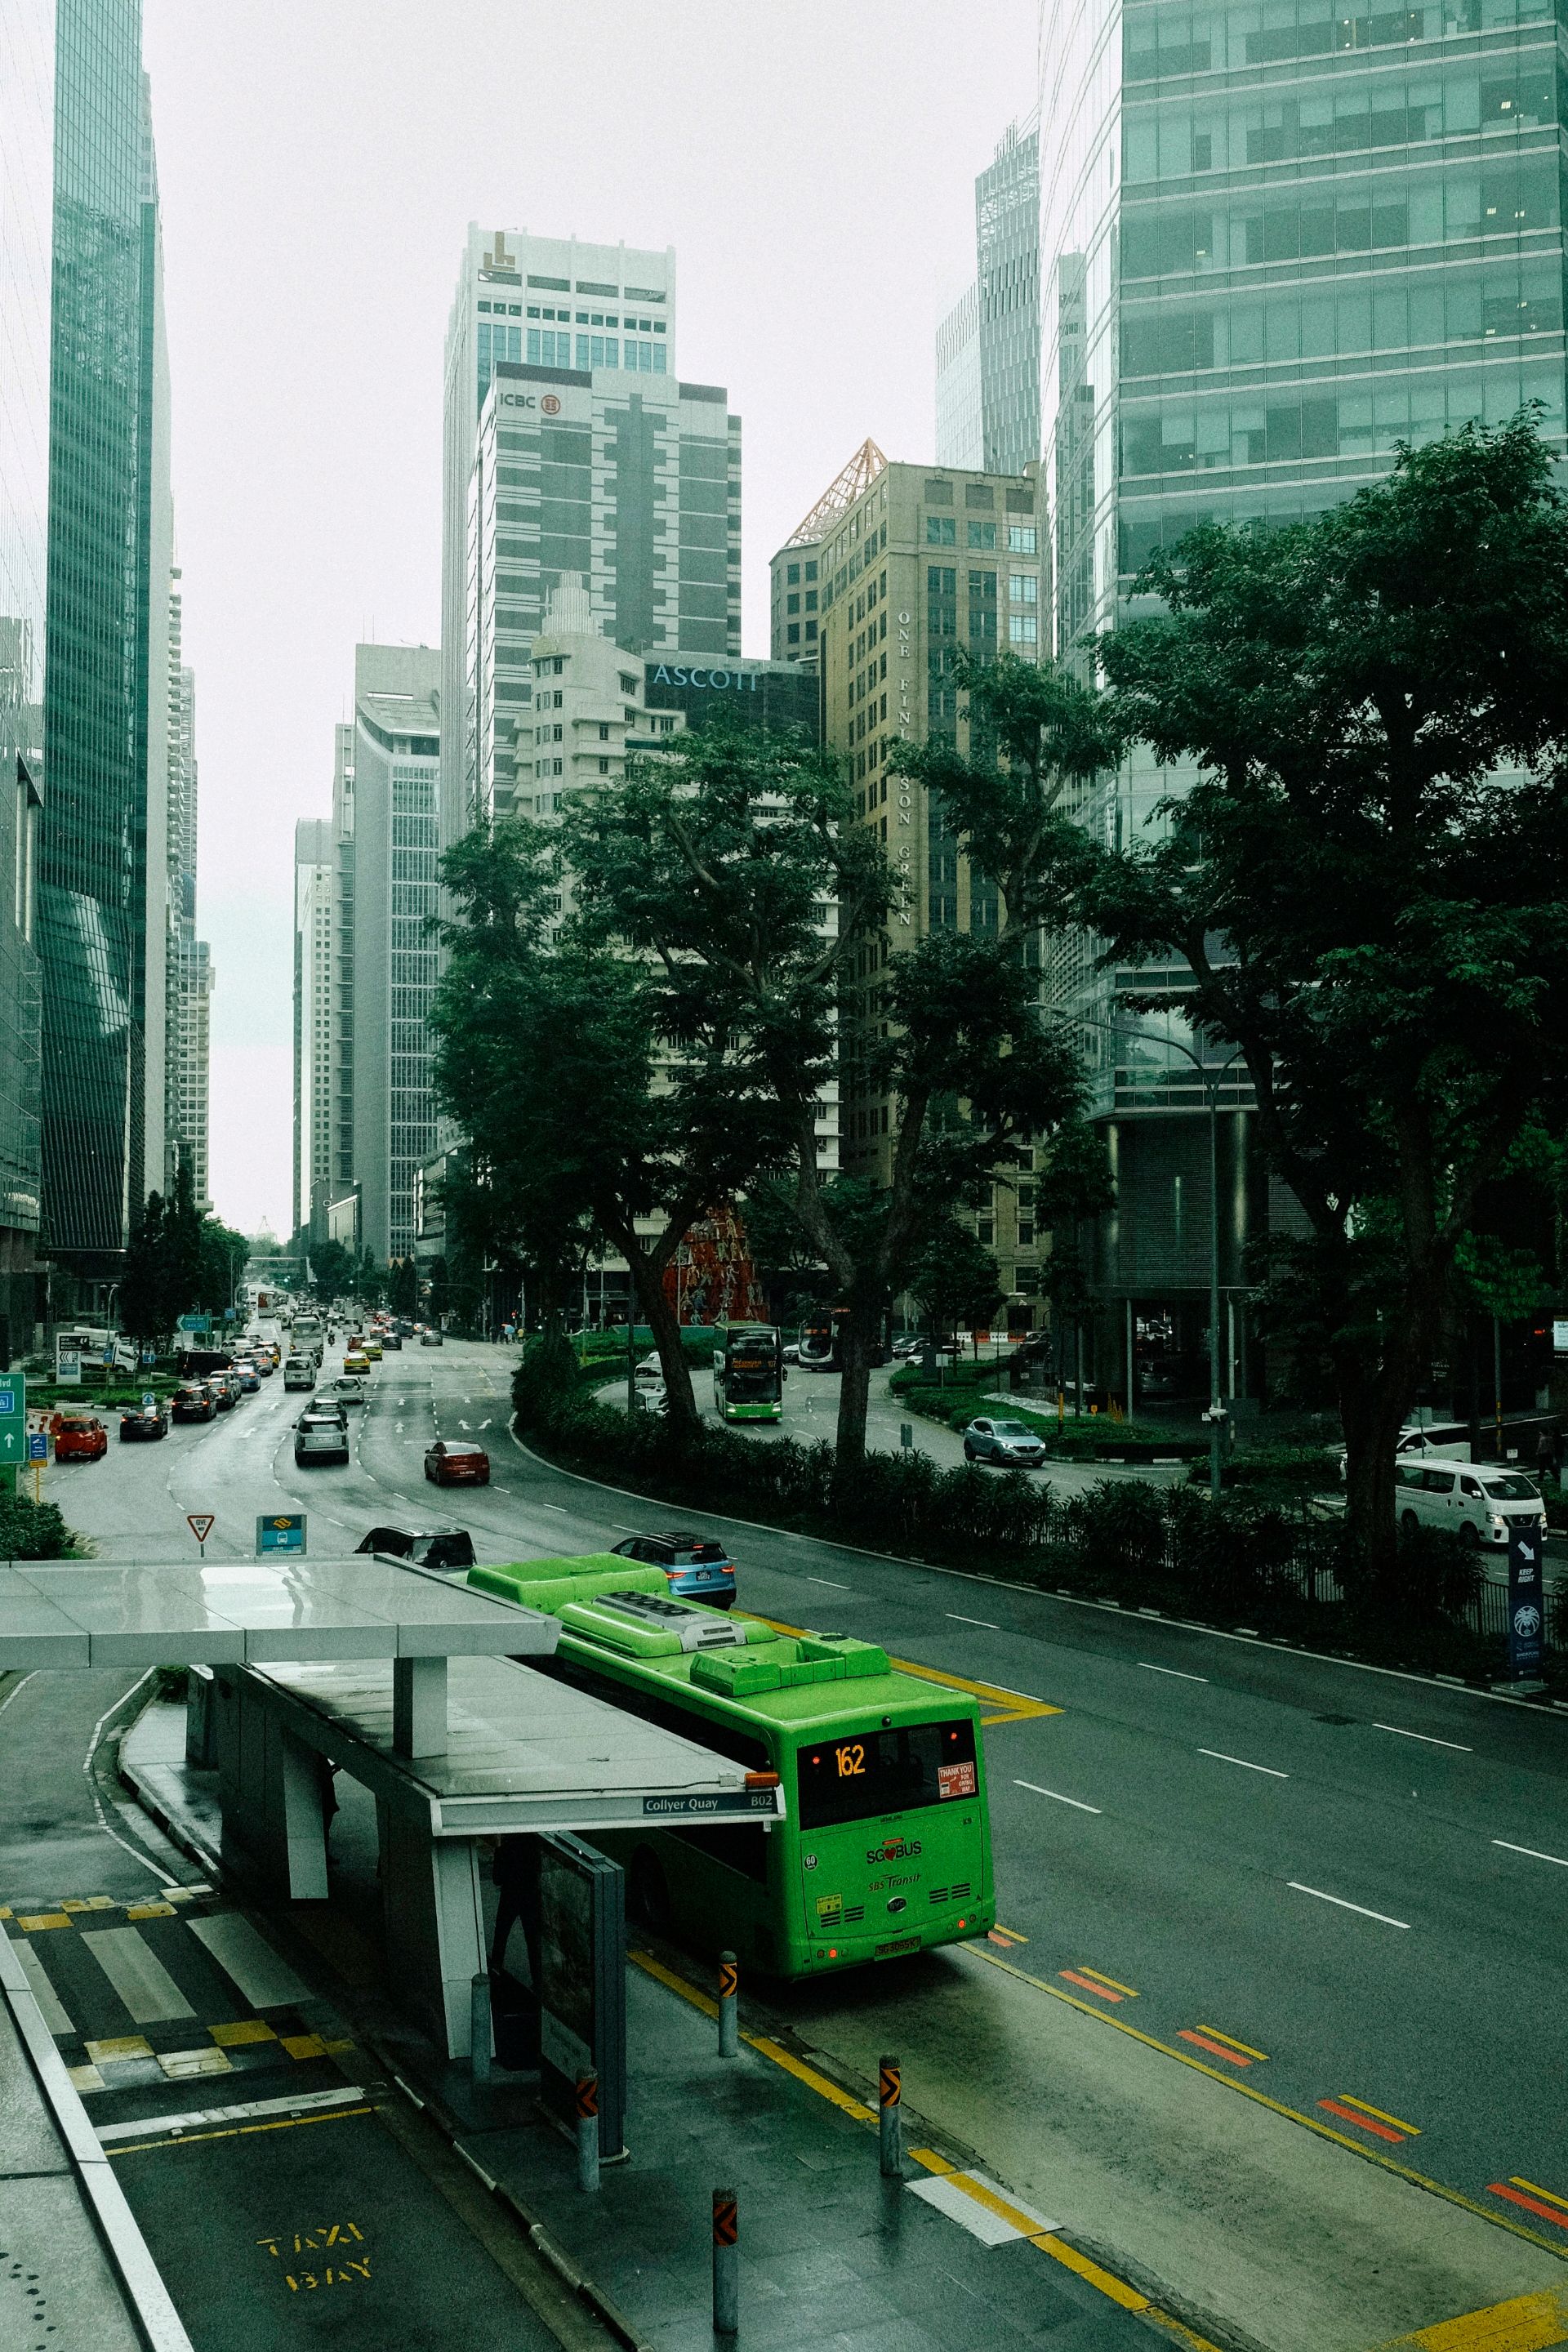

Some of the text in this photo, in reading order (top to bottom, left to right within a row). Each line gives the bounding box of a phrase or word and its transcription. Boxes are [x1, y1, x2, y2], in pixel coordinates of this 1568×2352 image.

[500, 393, 536, 409] ICBC
[653, 662, 762, 693] ASCOTT
[898, 612, 911, 926] ONE FINLSON GREEN
[0, 1378, 11, 1388] lvd
[1517, 1575, 1535, 1584] RIGHT
[1519, 1568, 1534, 1576] KEEP
[835, 1744, 866, 1777] 162
[939, 1764, 972, 1778] THANK YOU
[958, 1779, 973, 1787] GIVING
[646, 1796, 773, 1812] Collyer Quay B02
[806, 1855, 816, 1865] 60
[868, 1873, 921, 1892] SBS Transit
[256, 2222, 364, 2256] TAXI
[286, 2256, 372, 2292] BAY
